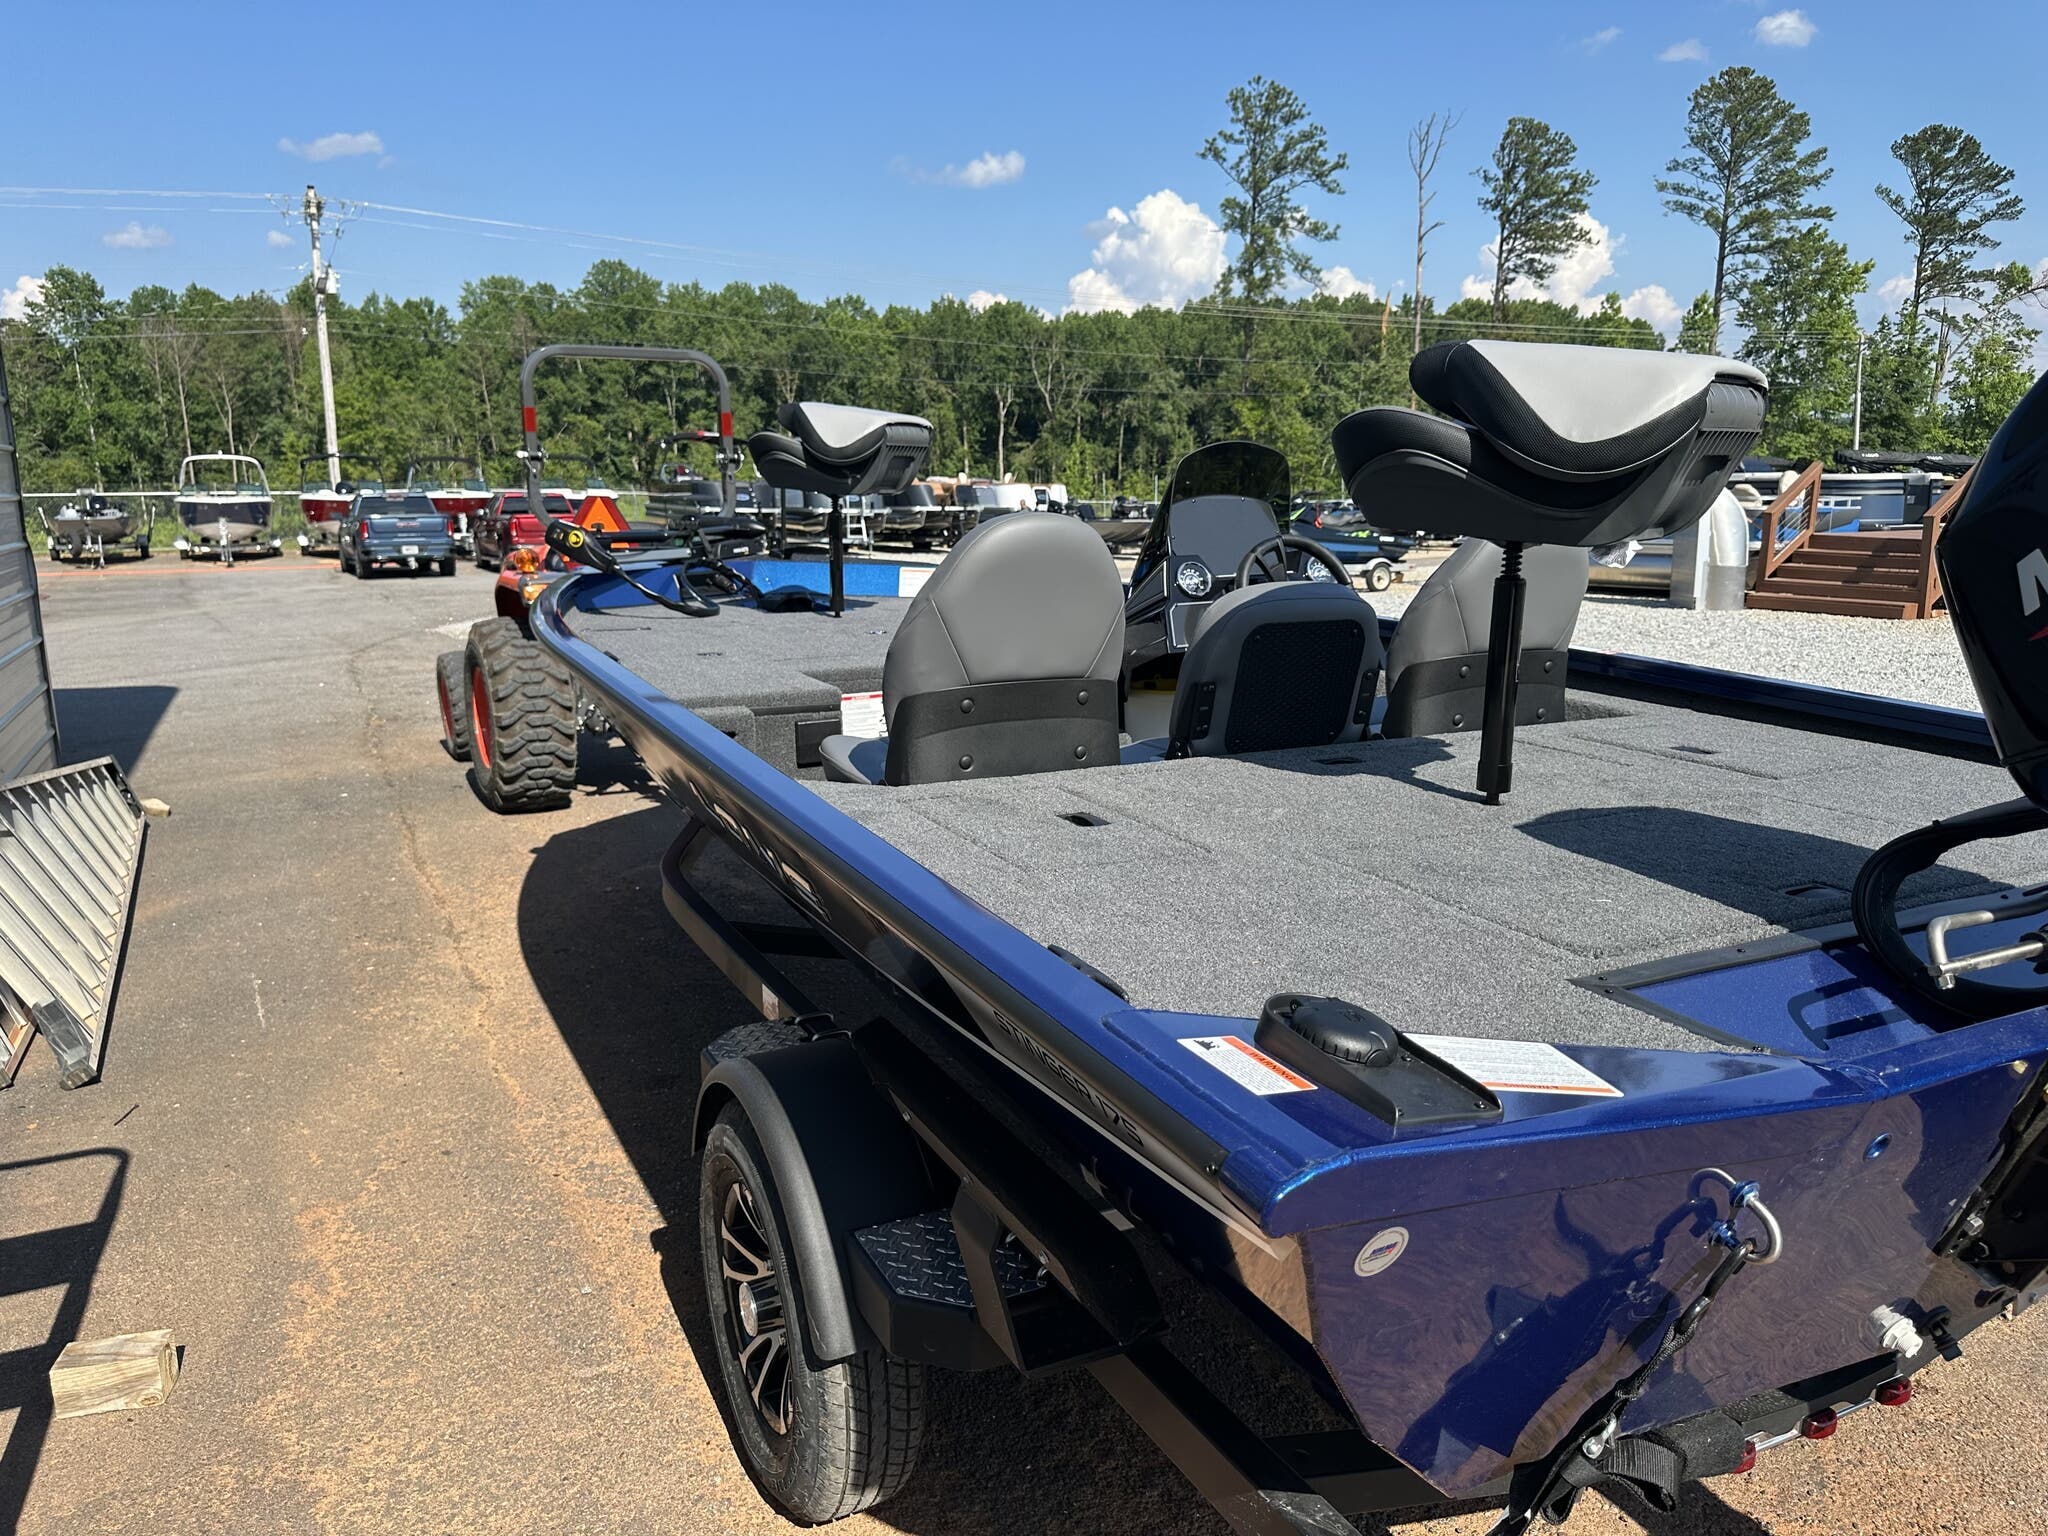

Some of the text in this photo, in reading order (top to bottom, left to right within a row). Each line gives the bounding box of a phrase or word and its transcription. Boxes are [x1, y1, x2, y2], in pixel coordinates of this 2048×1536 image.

[993, 1010, 1144, 1147] STINGER 175
[1249, 1052, 1297, 1081] WARNING
